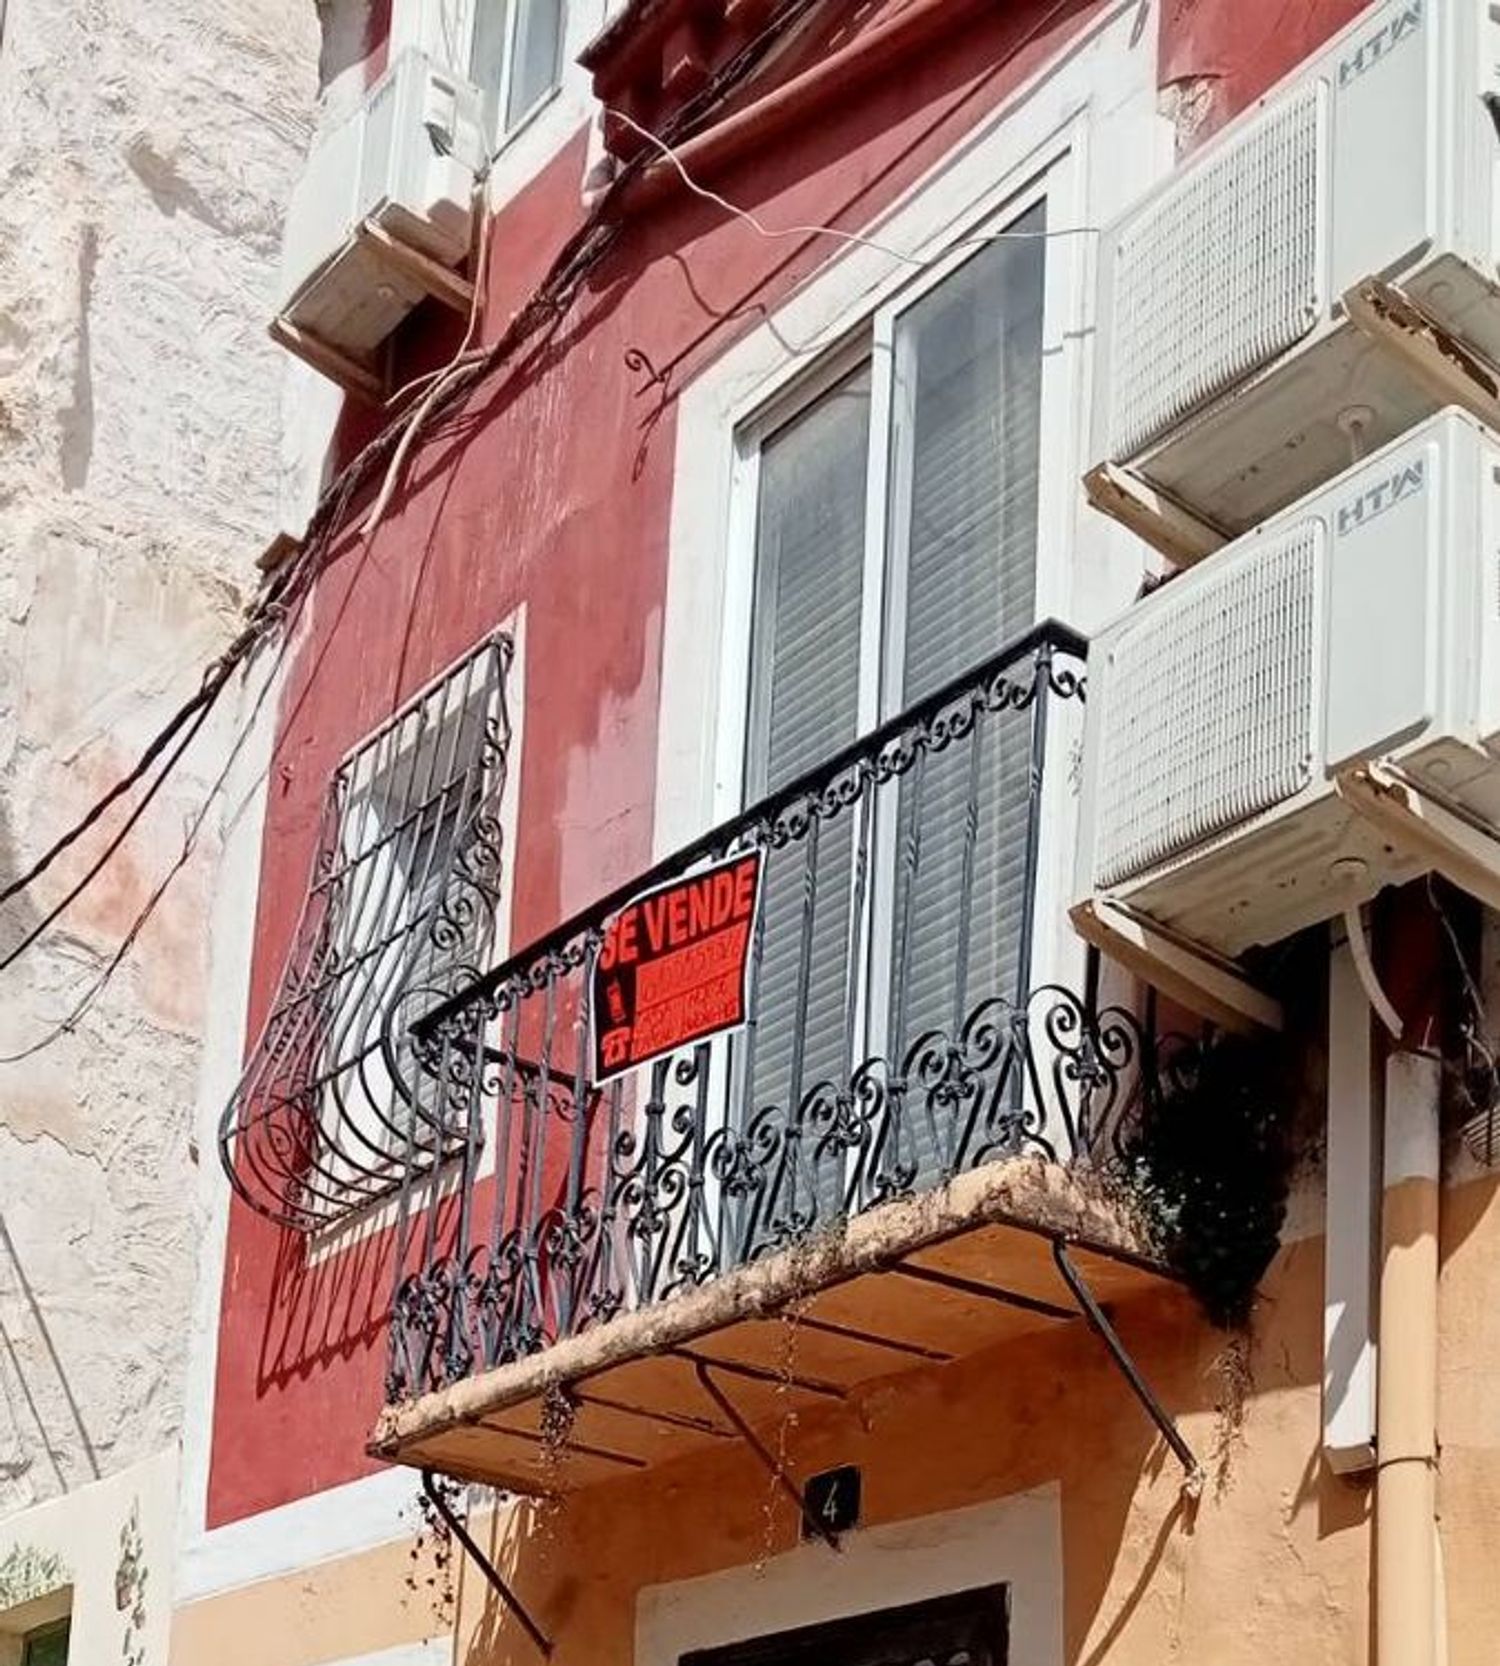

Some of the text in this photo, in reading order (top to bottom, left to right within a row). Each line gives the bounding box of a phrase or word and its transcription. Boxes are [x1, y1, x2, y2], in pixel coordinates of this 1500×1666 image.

[1337, 459, 1424, 532] HTW
[600, 859, 756, 972] SE VENDE
[821, 1480, 838, 1524] 4
